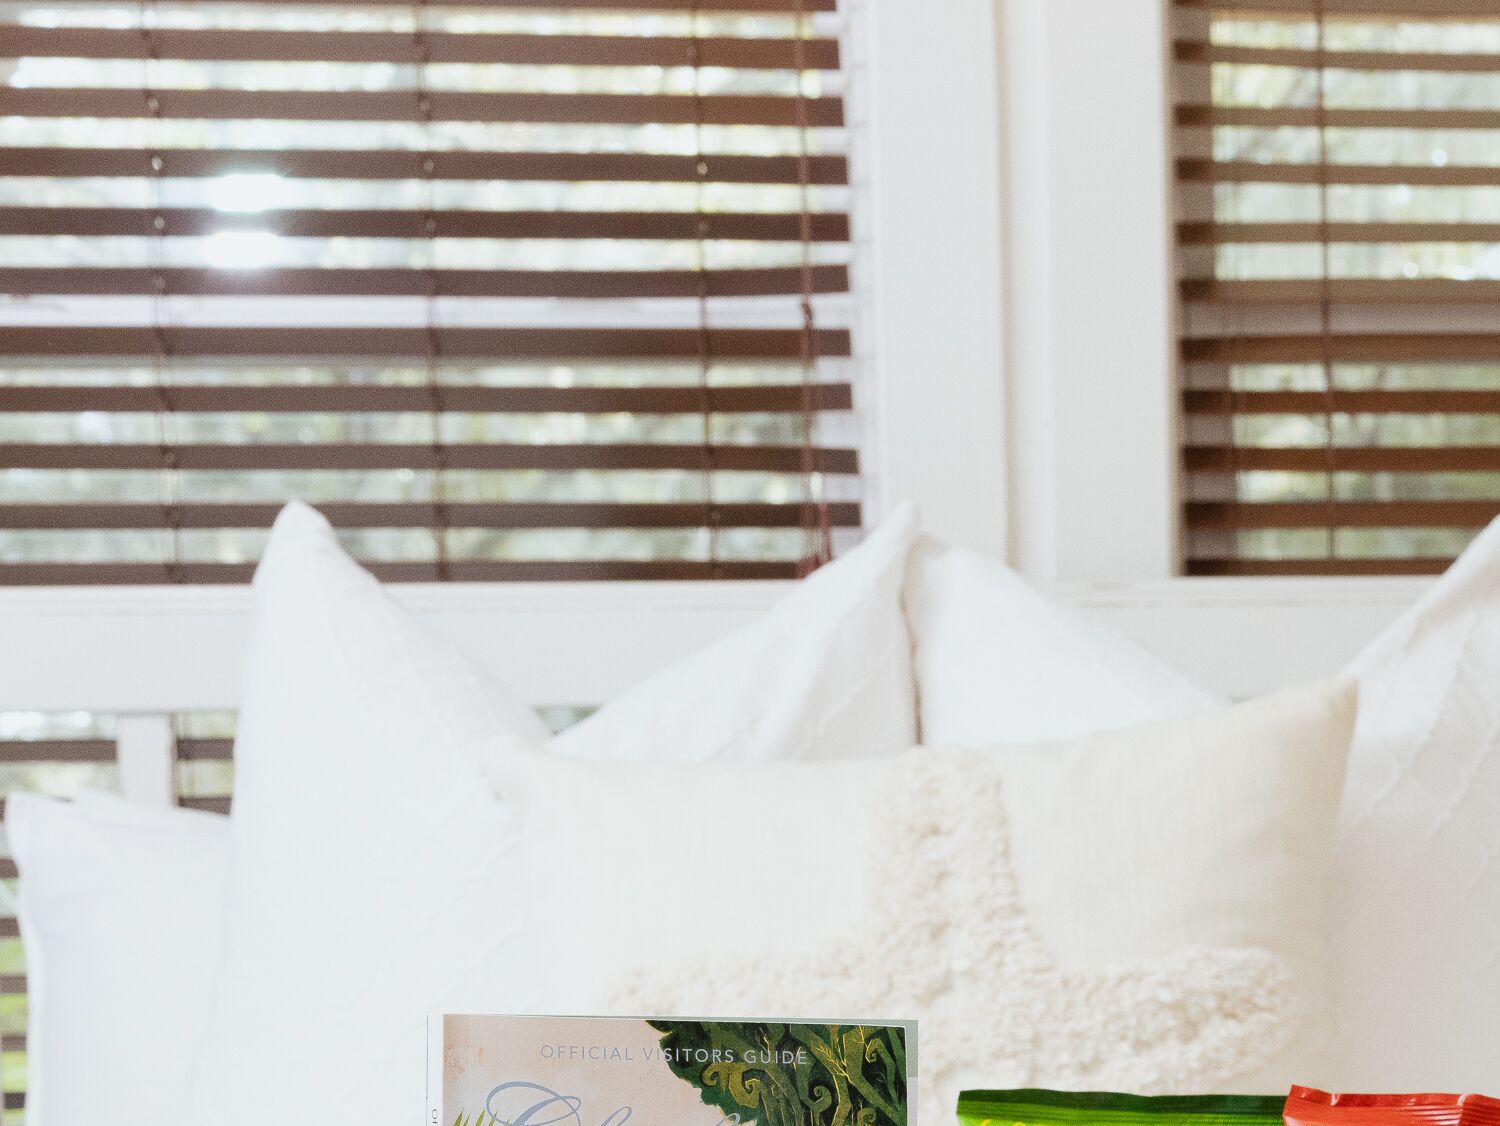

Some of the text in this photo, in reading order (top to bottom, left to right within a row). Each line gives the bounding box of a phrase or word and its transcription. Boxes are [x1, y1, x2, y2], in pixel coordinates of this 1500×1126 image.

[540, 1043, 808, 1066] OFFICIAL VISITORS GUIDE
